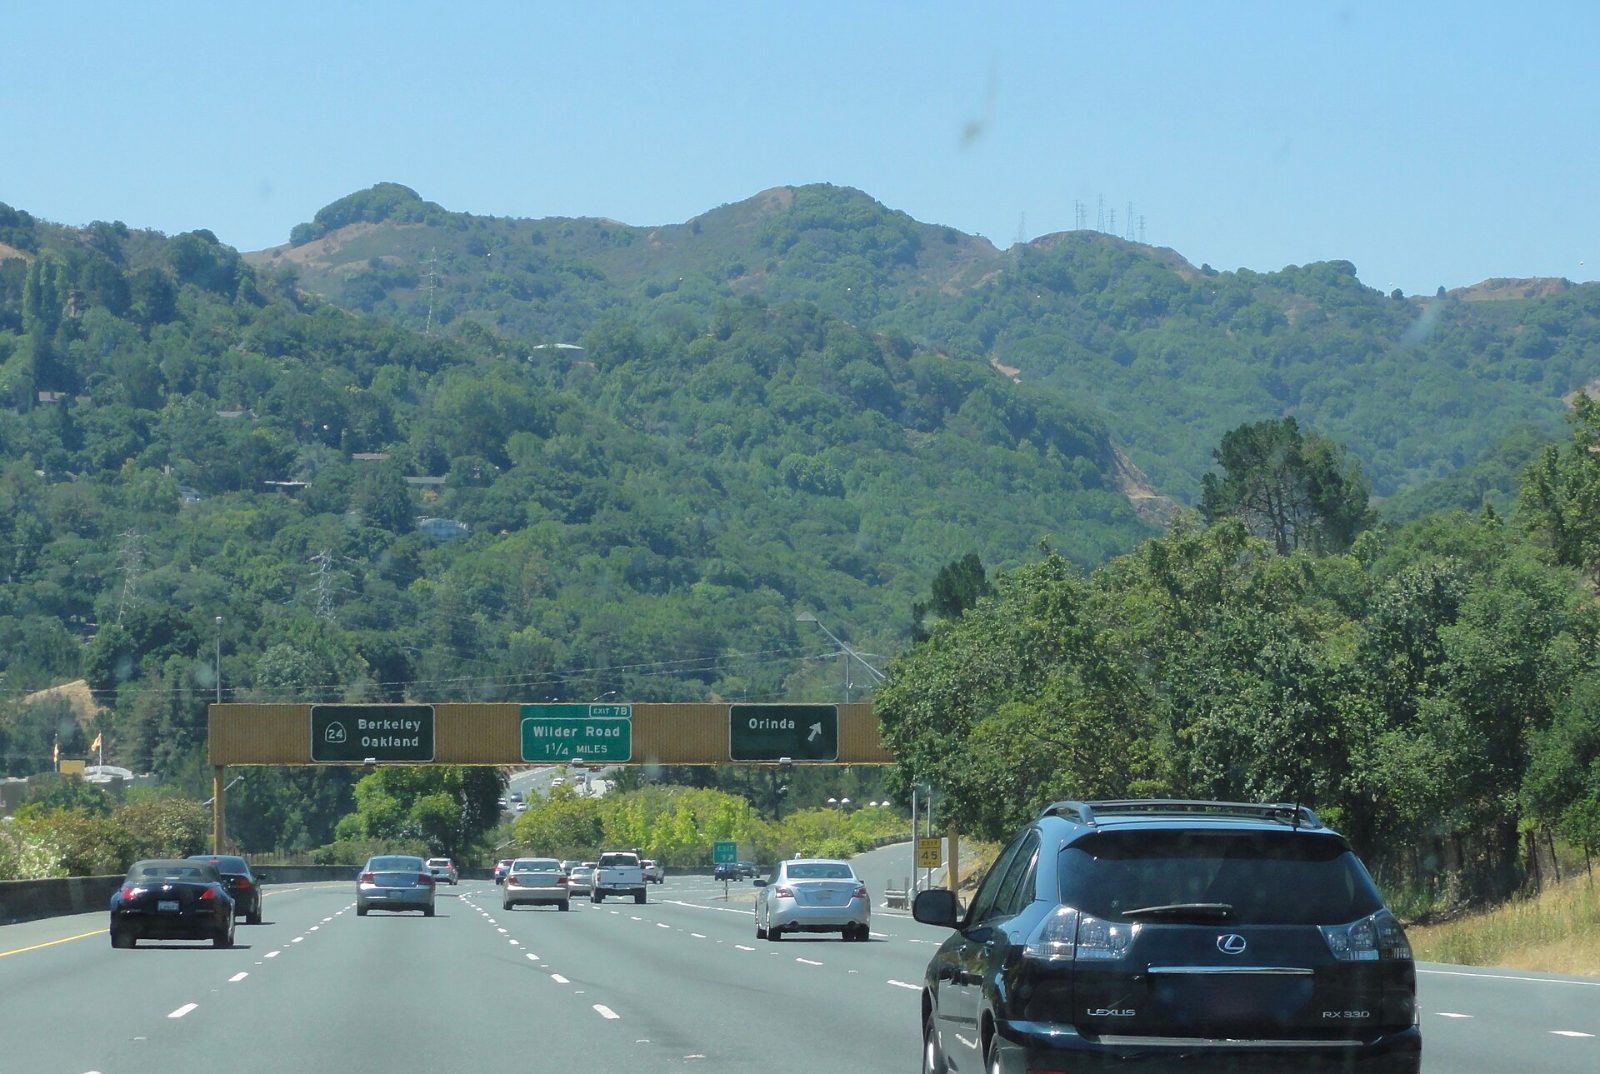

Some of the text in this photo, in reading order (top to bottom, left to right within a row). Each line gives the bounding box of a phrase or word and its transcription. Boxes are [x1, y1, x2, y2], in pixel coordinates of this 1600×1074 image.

[358, 719, 421, 732] Berkeley
[748, 718, 795, 729] Orinda
[328, 729, 344, 739] 24
[533, 726, 620, 737] Wilder Road
[361, 736, 419, 747] Oakland
[576, 745, 608, 754] MILES
[921, 850, 938, 860] 45
[1087, 1008, 1136, 1017] LEXUS
[1343, 1010, 1370, 1018] 330
